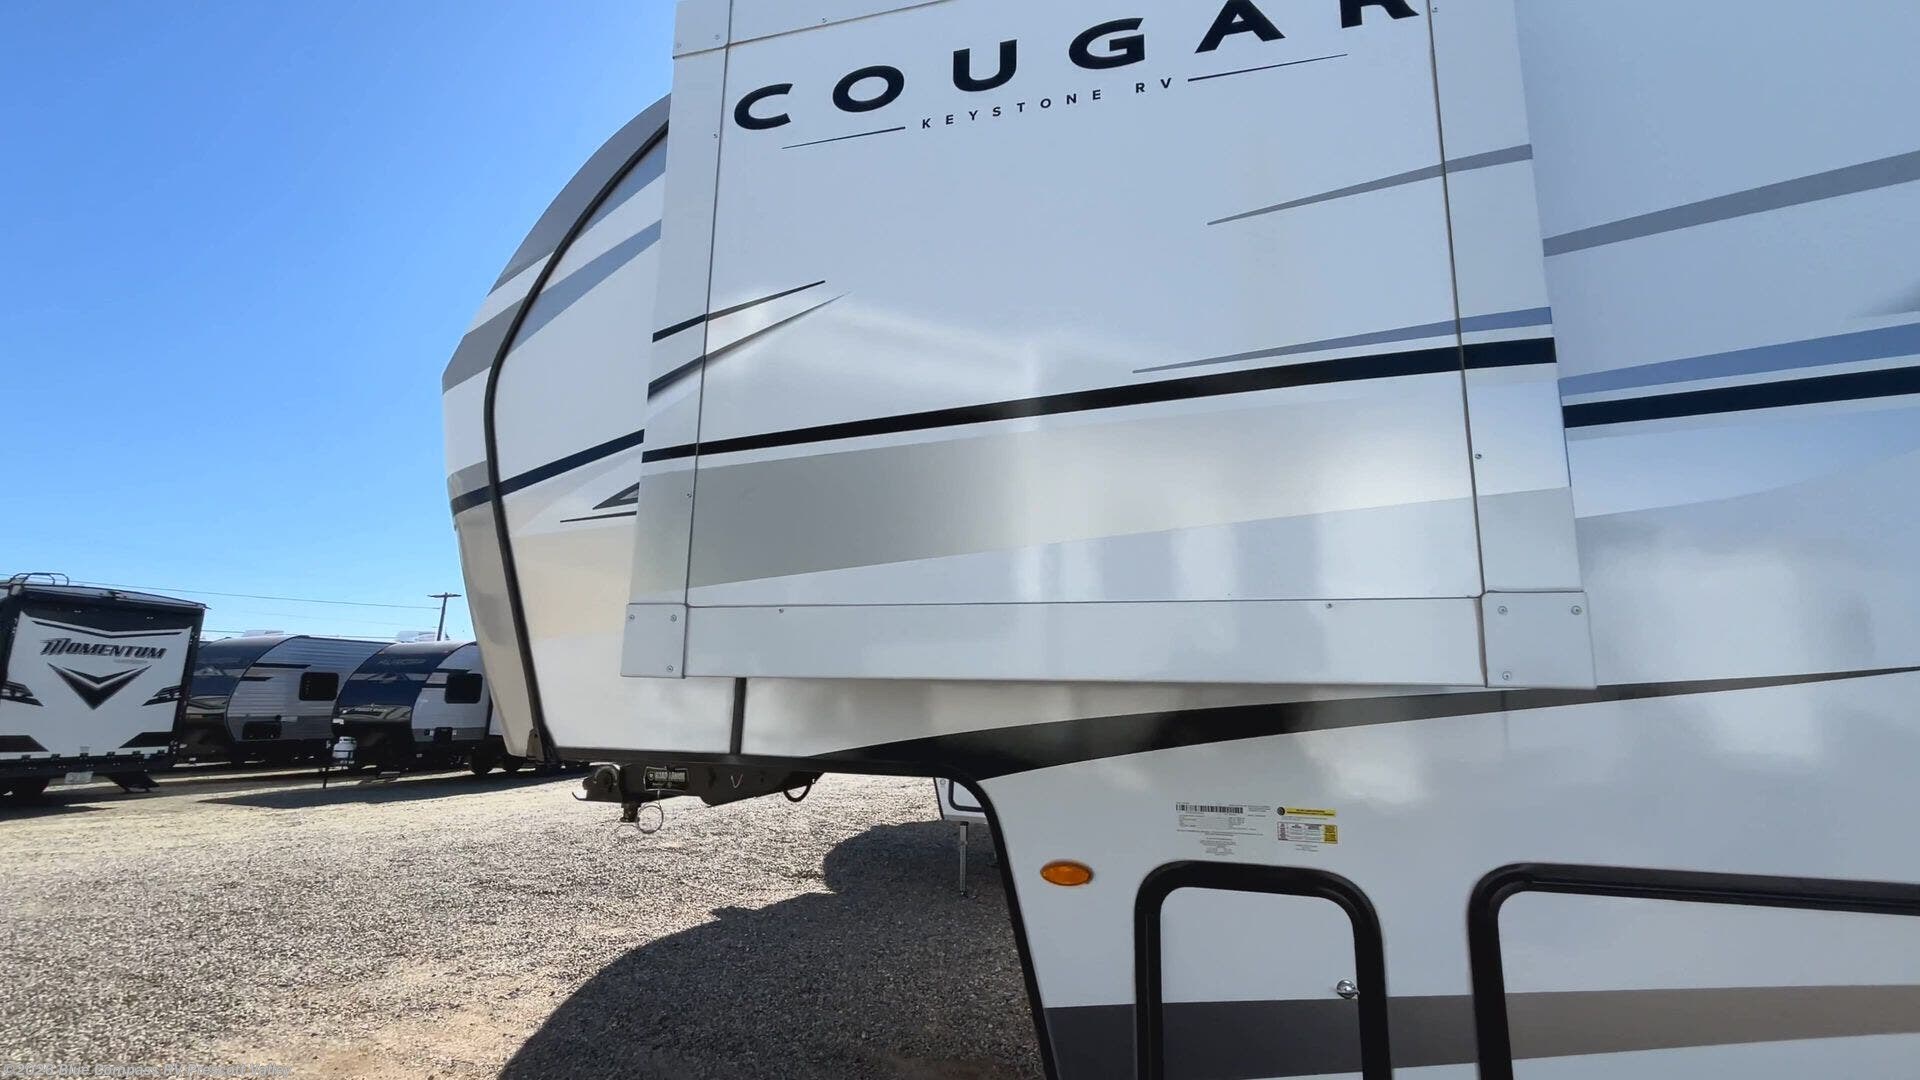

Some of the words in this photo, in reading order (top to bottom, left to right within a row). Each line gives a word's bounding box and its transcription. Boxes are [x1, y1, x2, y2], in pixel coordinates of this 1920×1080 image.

[921, 89, 1102, 129] KEYSTONE
[1135, 77, 1173, 94] RV
[40, 638, 168, 659] MOMENTUM
